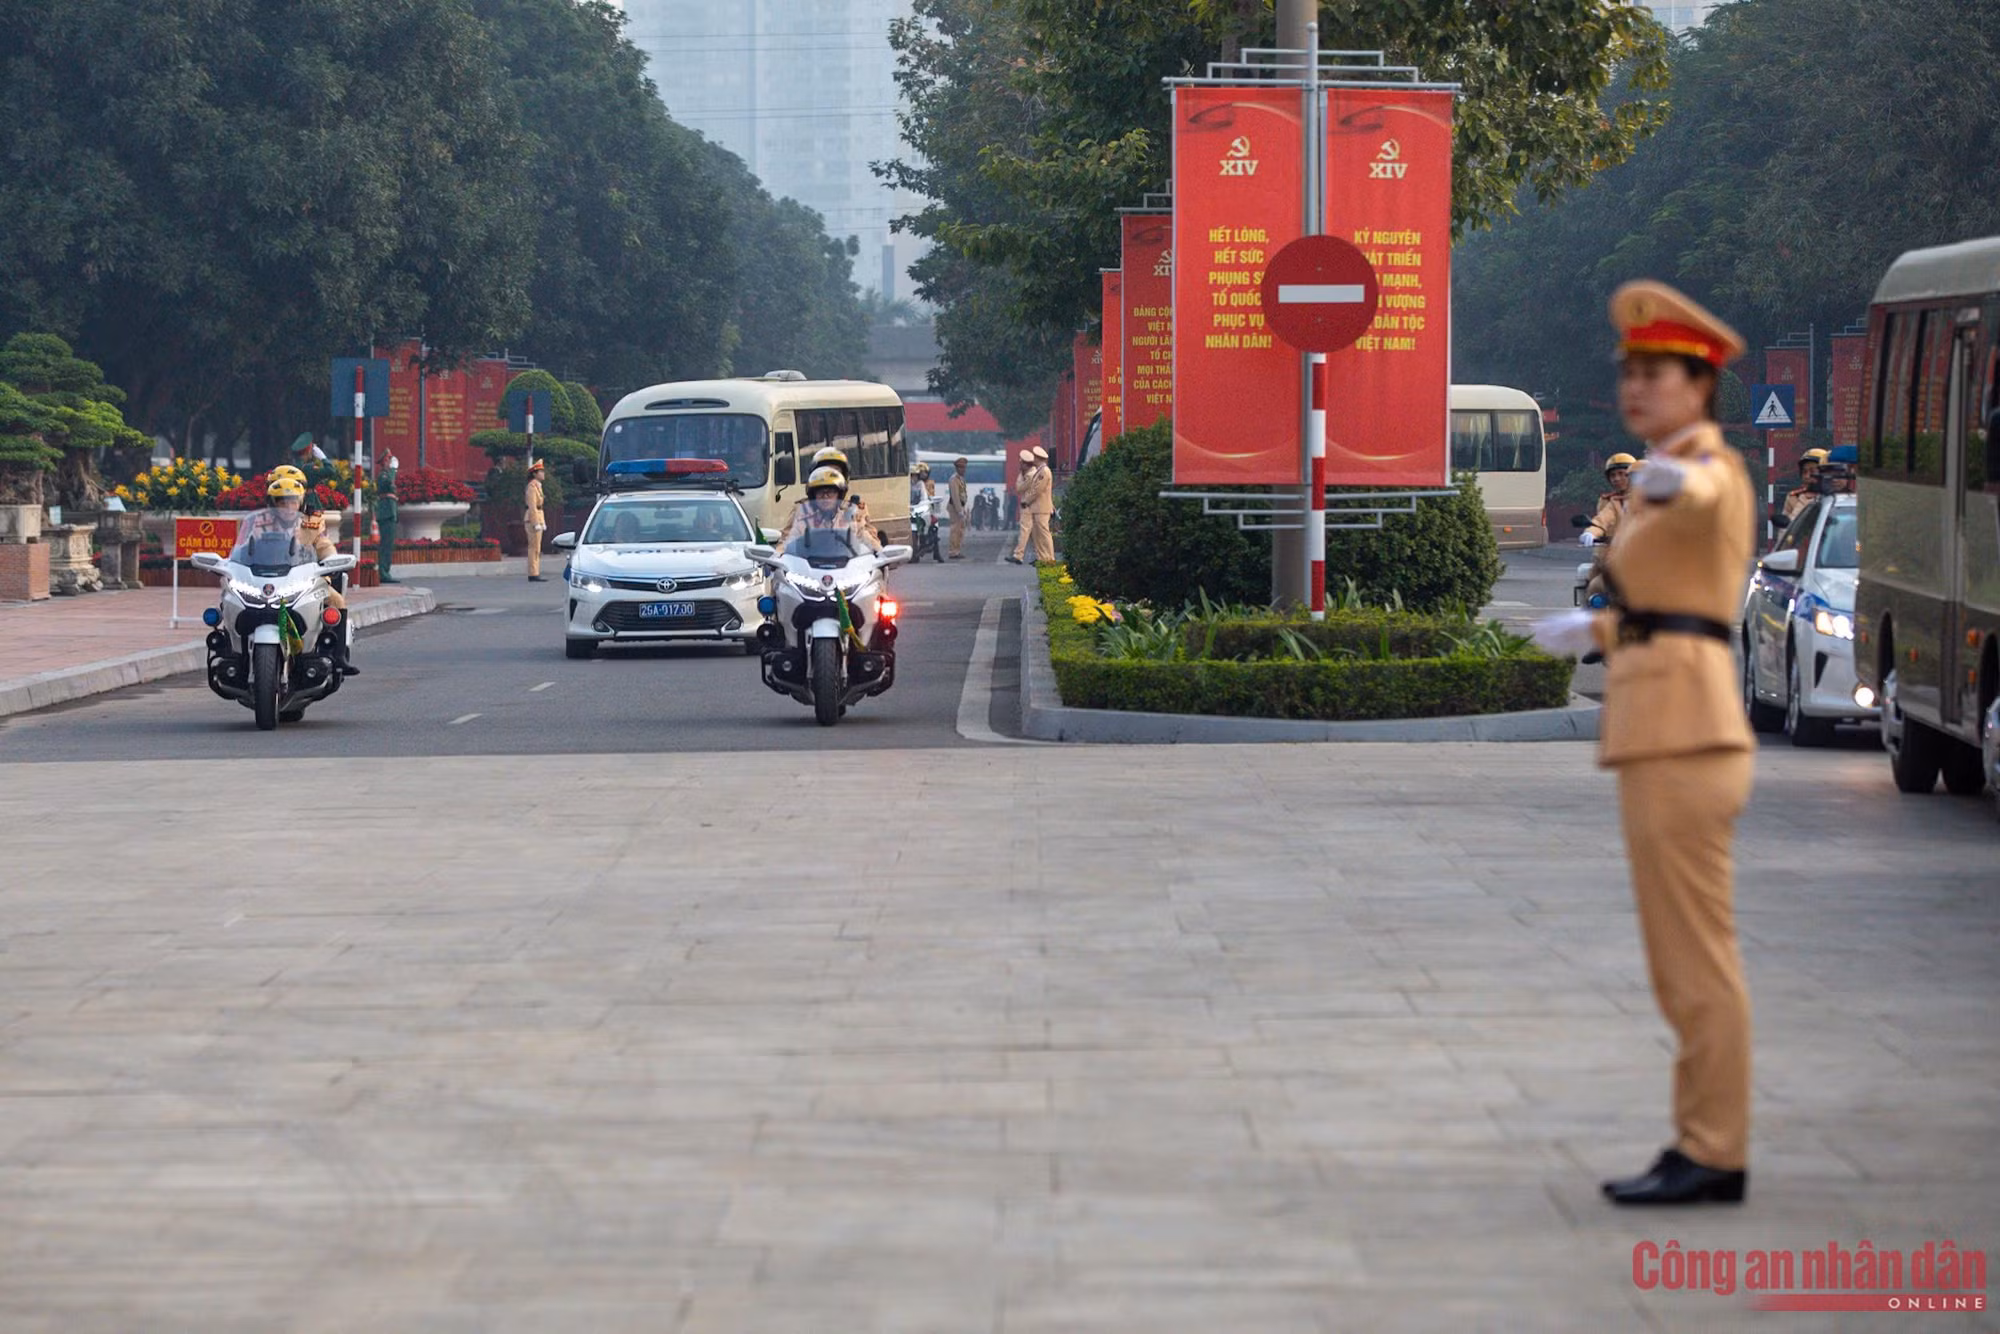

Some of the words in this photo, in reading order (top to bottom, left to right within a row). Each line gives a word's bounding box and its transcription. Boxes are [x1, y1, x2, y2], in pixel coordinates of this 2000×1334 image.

[1220, 160, 1258, 175] XIV
[1369, 163, 1408, 178] XIV
[1209, 225, 1231, 242] HẾT
[1234, 226, 1269, 244] LÒNG,
[1354, 226, 1370, 244] KỶ
[1373, 229, 1421, 245] NGUYÊN
[1214, 247, 1236, 264] HẾT
[1240, 247, 1264, 264] SỨC
[1387, 248, 1421, 266] TRIỂN
[1208, 272, 1250, 288] PHỤNG
[1254, 272, 1264, 285] S
[1383, 274, 1422, 290] MẠNH,
[1386, 294, 1425, 311] VƯỢNG
[1147, 321, 1164, 333] VIỆT
[1213, 314, 1246, 330] PHỤC
[1249, 314, 1264, 330] VỤ
[1374, 313, 1399, 328] DÂN
[1402, 314, 1424, 332] TỘC
[1132, 335, 1158, 346] NGƯỜI
[1205, 333, 1239, 348] NHÂN
[1242, 333, 1272, 348] DÂN!
[1383, 336, 1416, 350] NAM!
[1137, 365, 1154, 376] MỌI
[1134, 378, 1150, 390] CỦA
[1146, 392, 1164, 405] VIỆT
[179, 534, 202, 547] CẤM
[221, 538, 232, 548] XE
